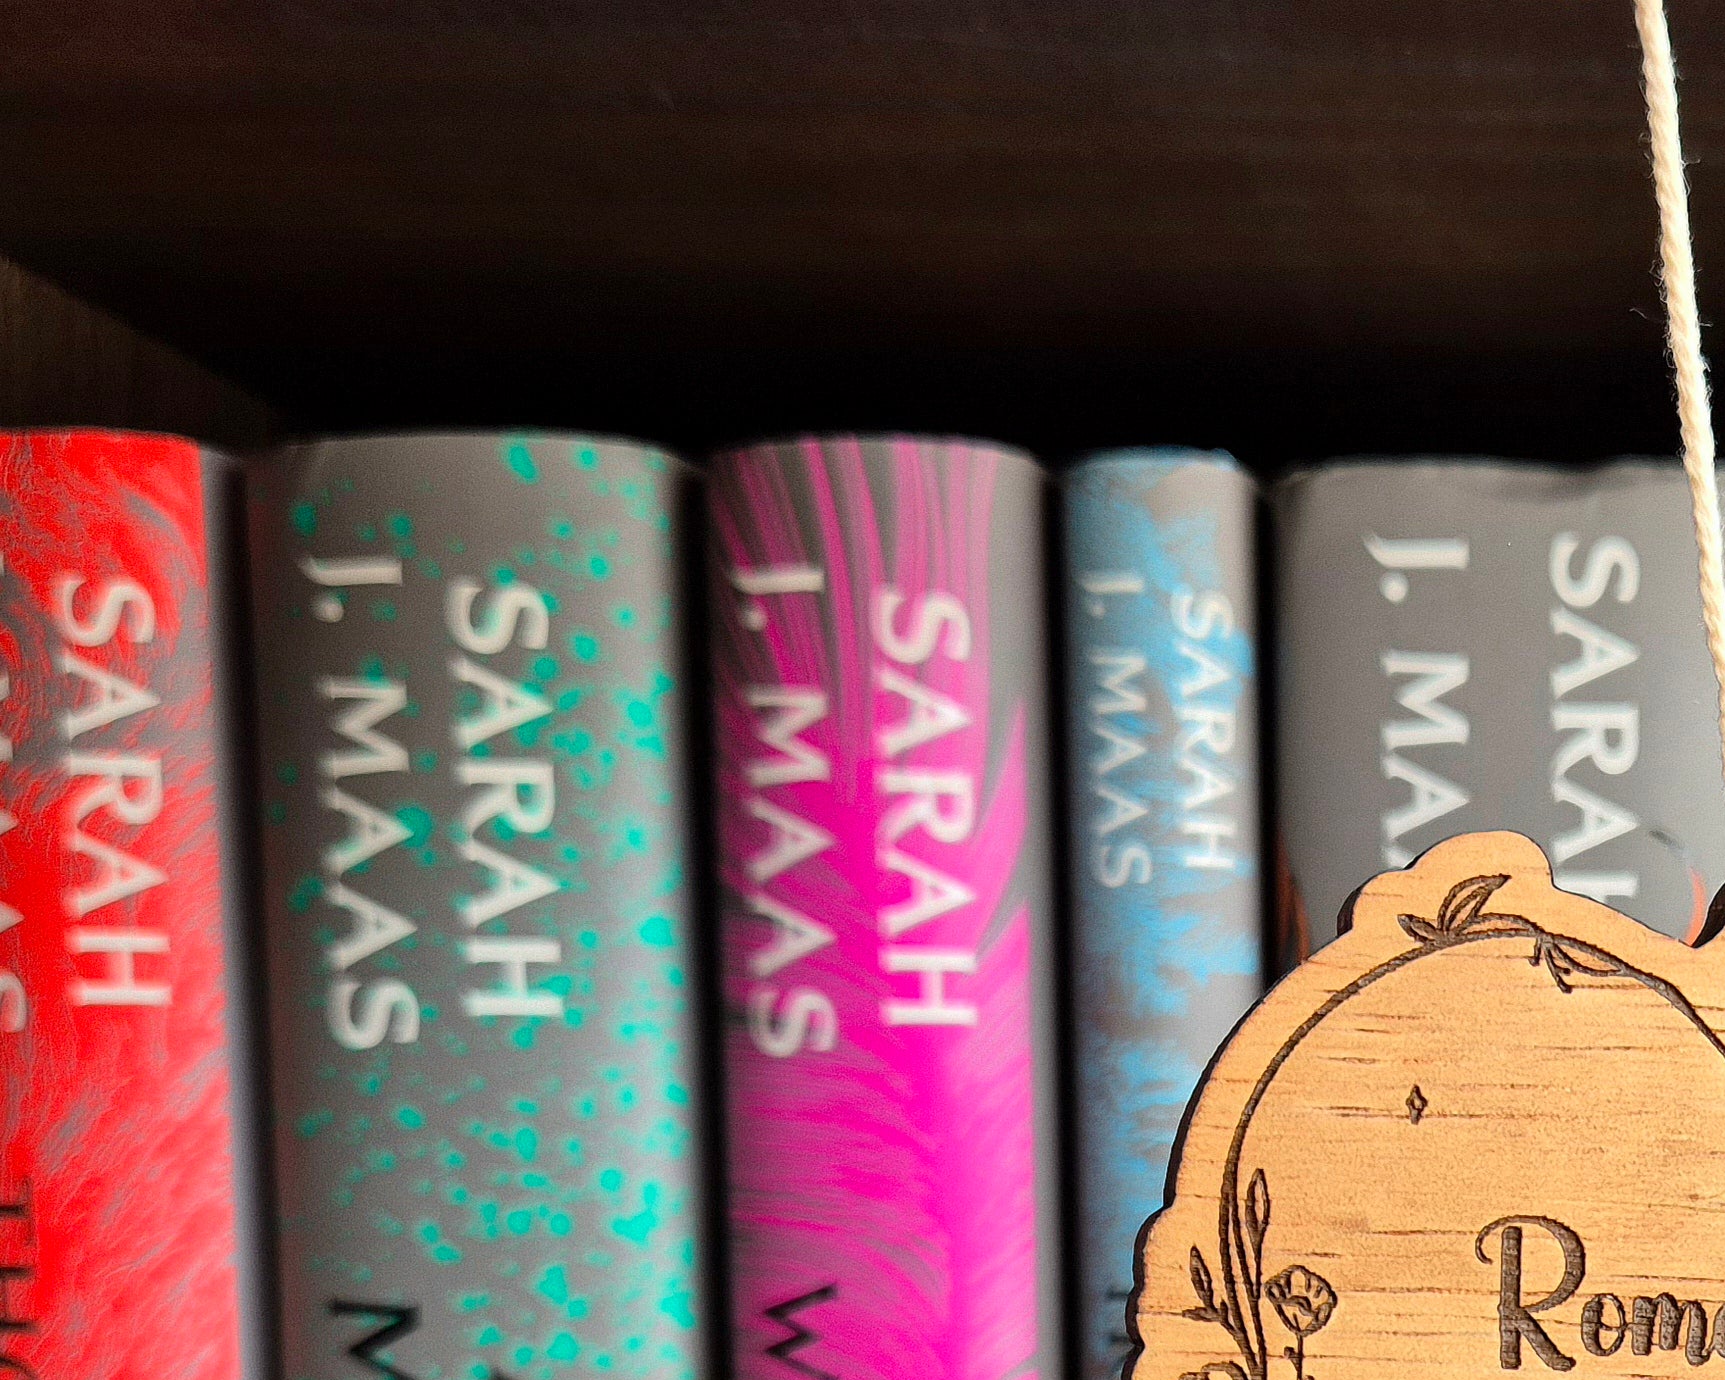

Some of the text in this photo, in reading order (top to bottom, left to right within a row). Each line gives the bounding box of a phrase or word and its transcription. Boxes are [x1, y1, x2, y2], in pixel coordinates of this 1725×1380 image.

[55, 573, 173, 1008] SARAH
[303, 556, 422, 1050] J. MAAS
[445, 576, 564, 1018] SARAH
[730, 565, 840, 1058] J. MAAS
[870, 583, 978, 1028] SARAH
[1074, 570, 1152, 888] J. MAAS
[1170, 583, 1238, 869] SARAH
[1362, 532, 1472, 868] J. MA
